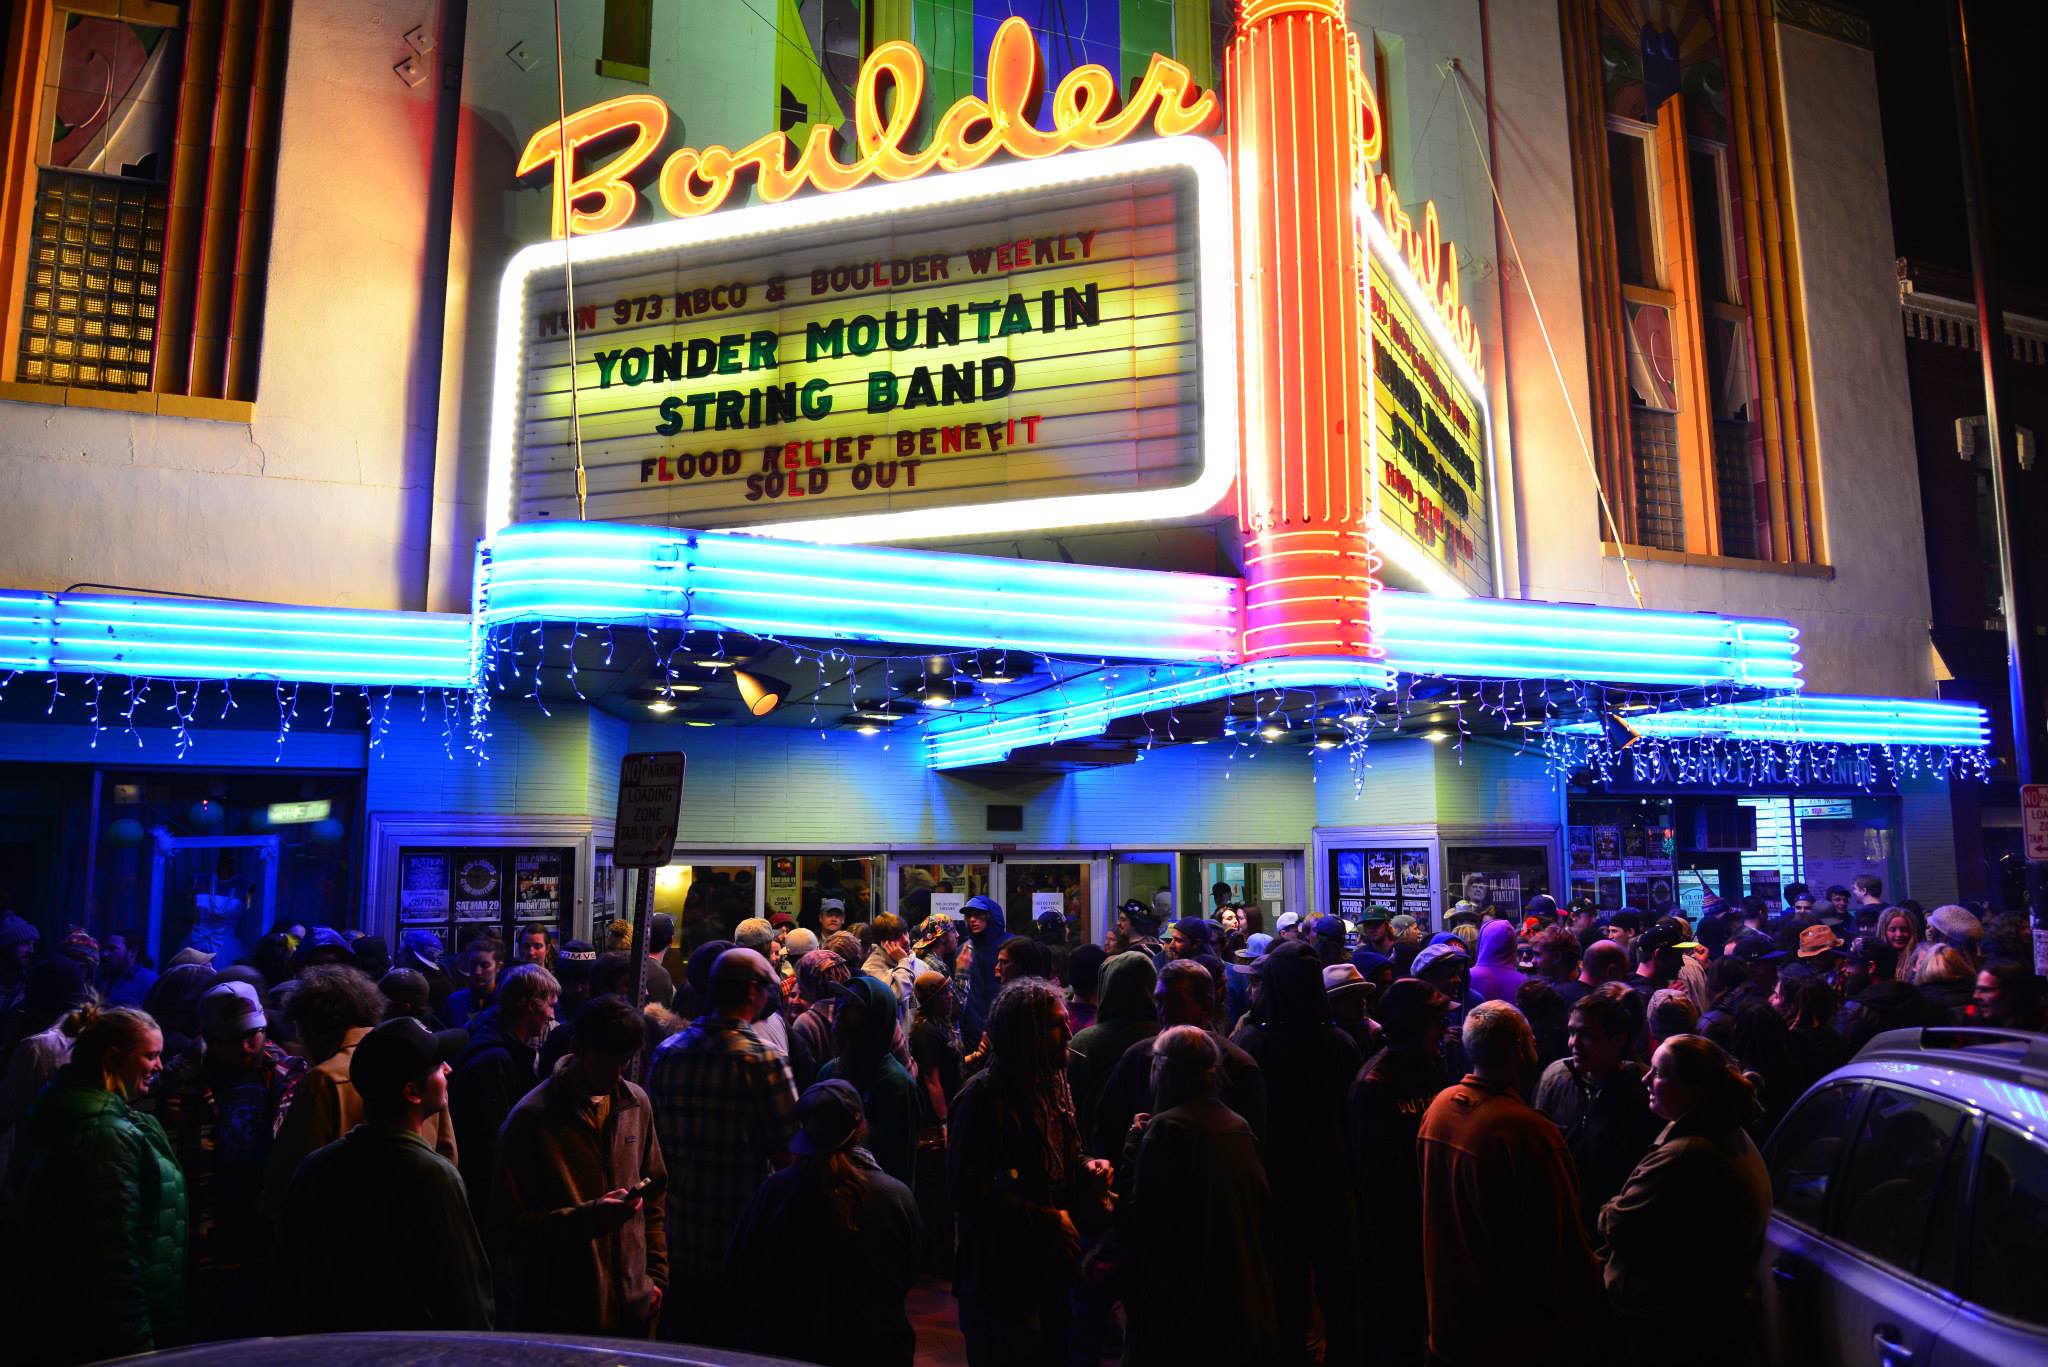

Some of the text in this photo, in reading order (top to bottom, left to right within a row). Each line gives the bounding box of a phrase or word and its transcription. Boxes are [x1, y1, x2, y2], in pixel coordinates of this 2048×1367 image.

[515, 16, 1220, 241] Boulder
[538, 229, 1097, 337] MON 973 KBCO & BOULDER WEEKLY
[594, 282, 1101, 390] YONDER MOUNTAIN
[656, 356, 1016, 438] STRING BAND
[640, 415, 1043, 483] FLOOD RELIEF BENEFIT
[745, 459, 922, 502] SOLD OUT
[623, 761, 640, 785] NO
[628, 788, 673, 803] LOADING
[2024, 791, 2040, 807] NO
[633, 807, 664, 822] ZONE
